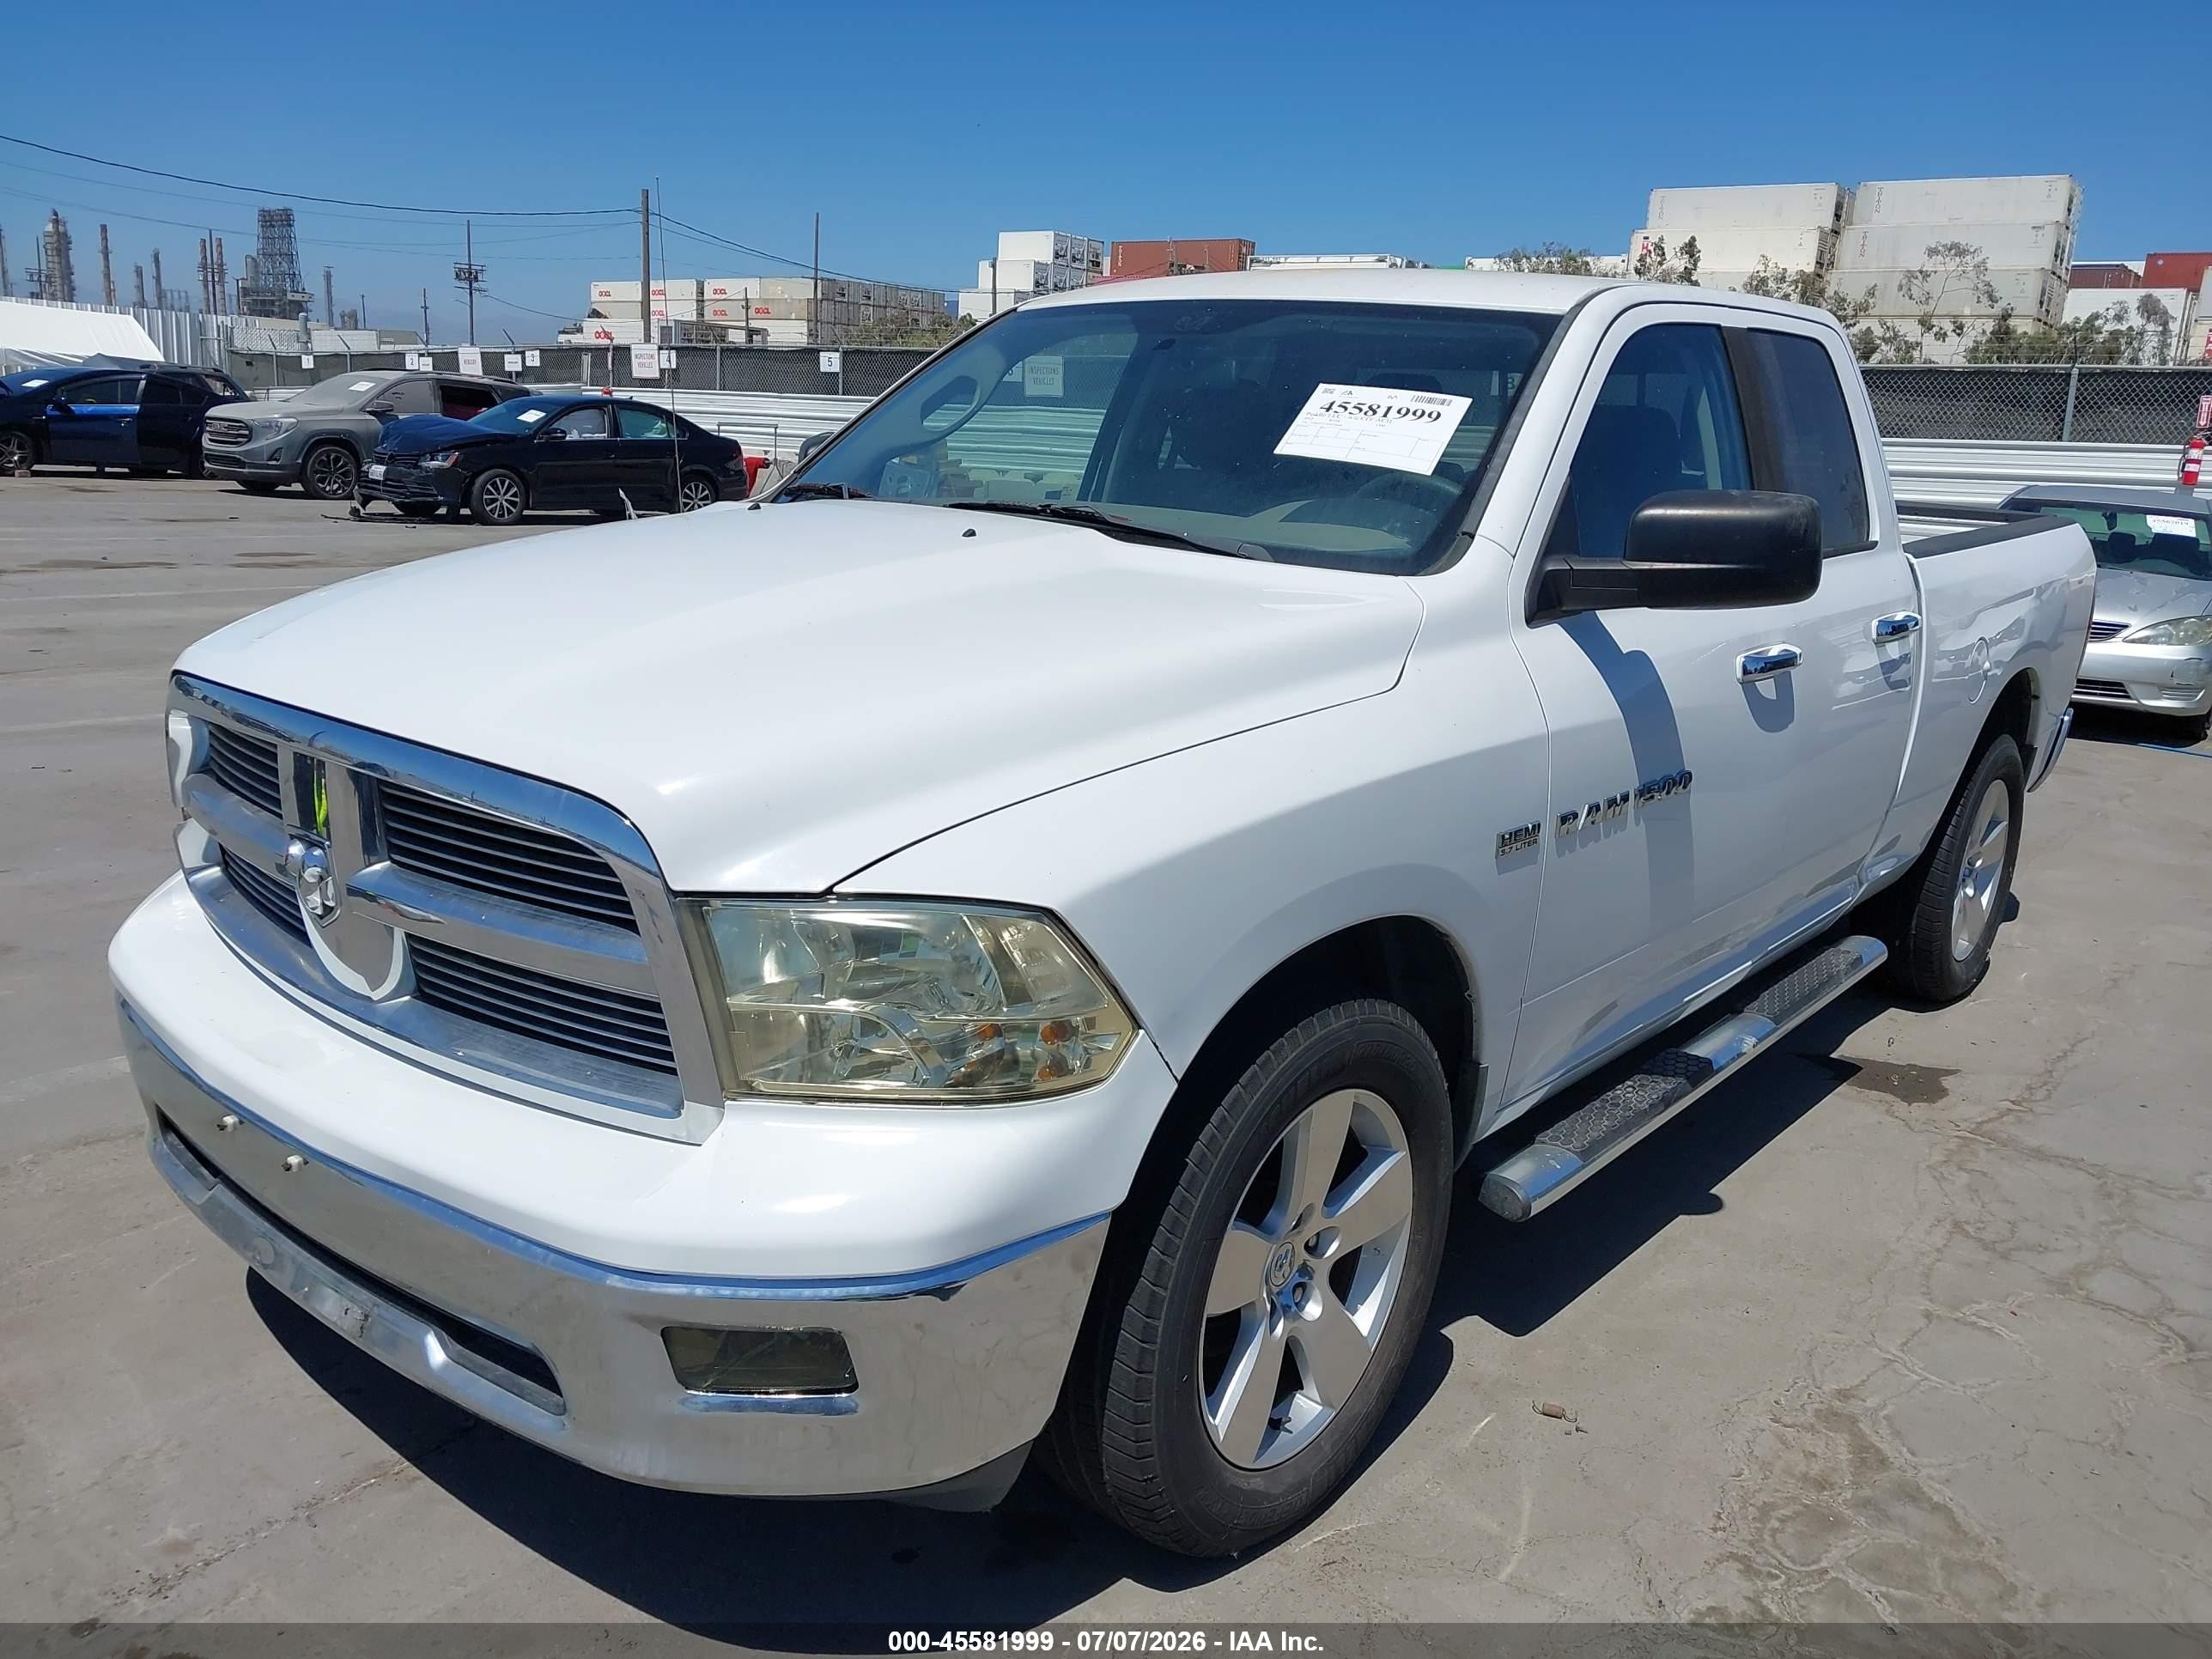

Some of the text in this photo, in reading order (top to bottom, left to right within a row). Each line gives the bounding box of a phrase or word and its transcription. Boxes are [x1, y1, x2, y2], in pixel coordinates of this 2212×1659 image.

[827, 356, 833, 368] 5
[1028, 366, 1060, 375] INSPECTIONS
[1032, 377, 1055, 386] VEHICLES
[1319, 399, 1442, 424] 45581999
[1555, 769, 1693, 839] RAM 1500
[1498, 822, 1541, 848] HEMI
[1515, 838, 1538, 851] LITER
